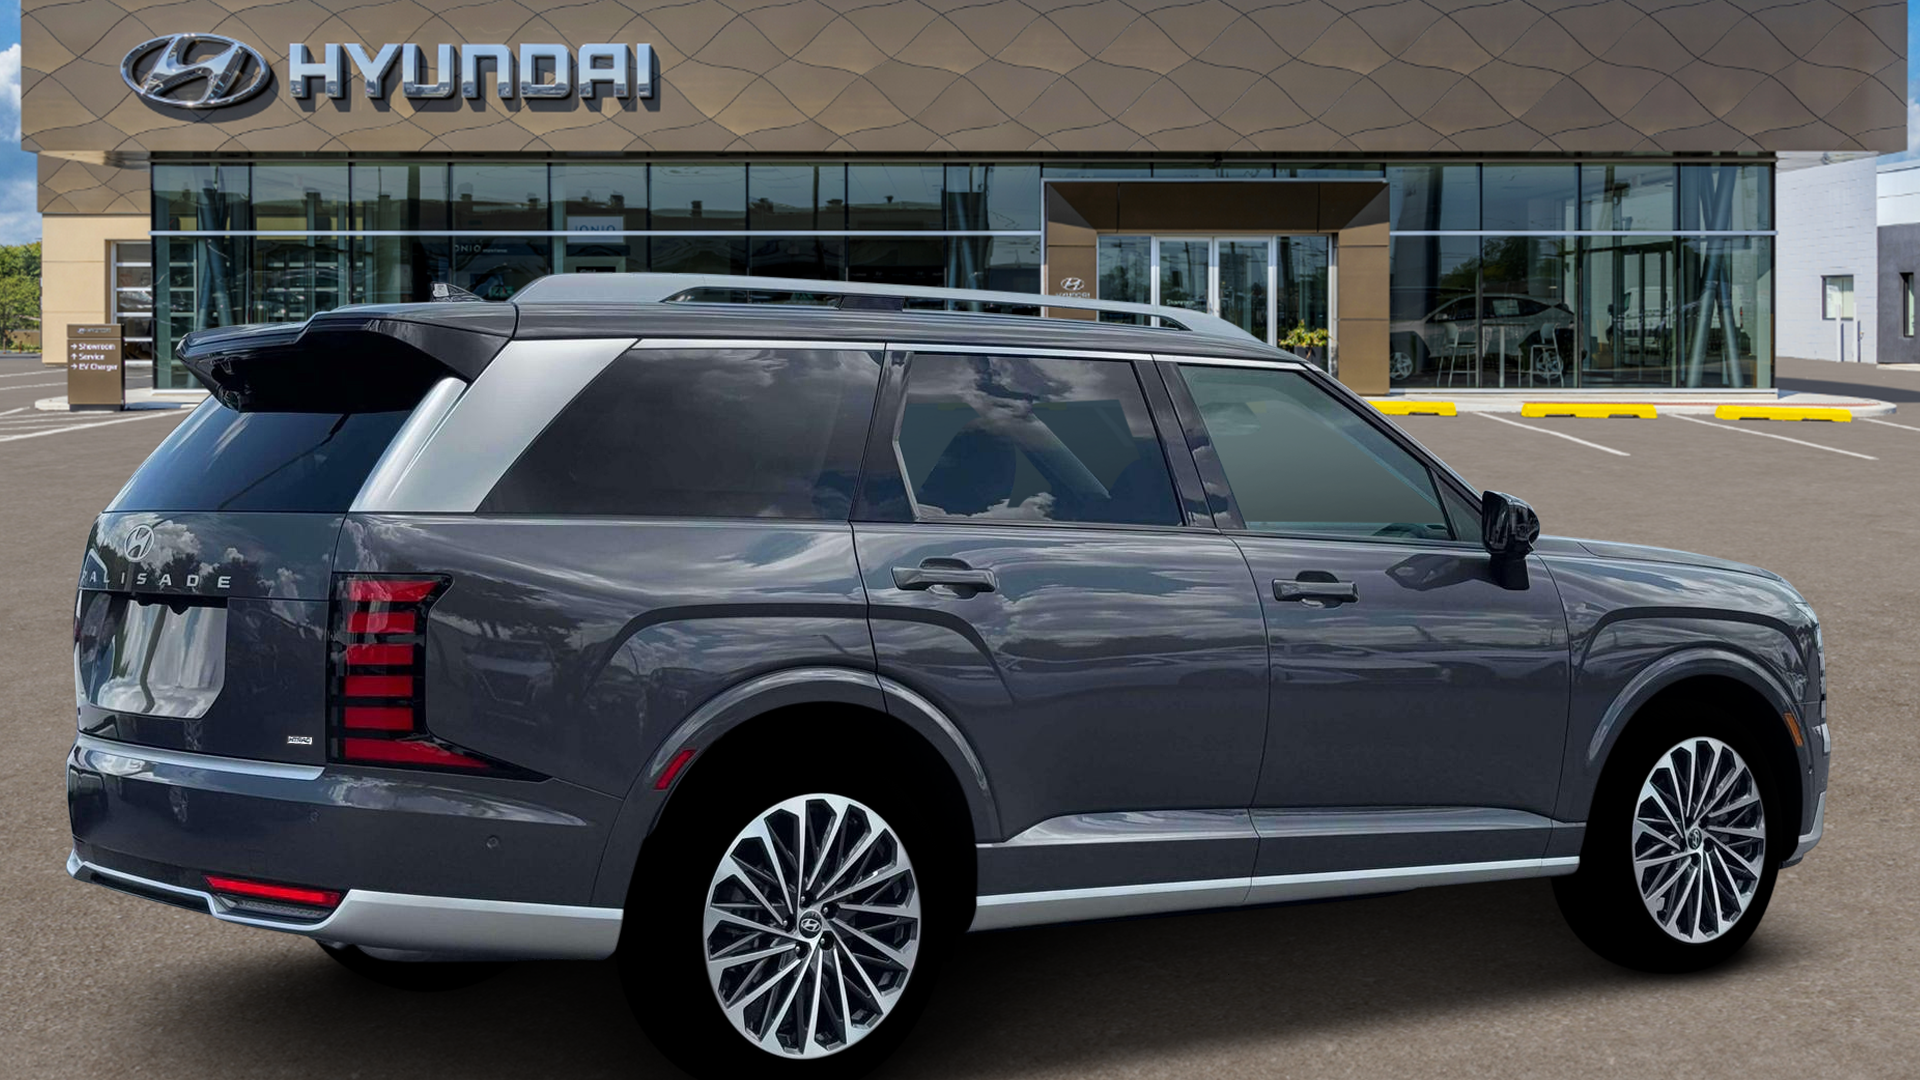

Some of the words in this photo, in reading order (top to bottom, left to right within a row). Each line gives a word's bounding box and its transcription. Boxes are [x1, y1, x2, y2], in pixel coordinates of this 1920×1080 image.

[289, 43, 654, 99] HYUNDAI
[78, 352, 105, 360] Service
[90, 363, 118, 372] Charger
